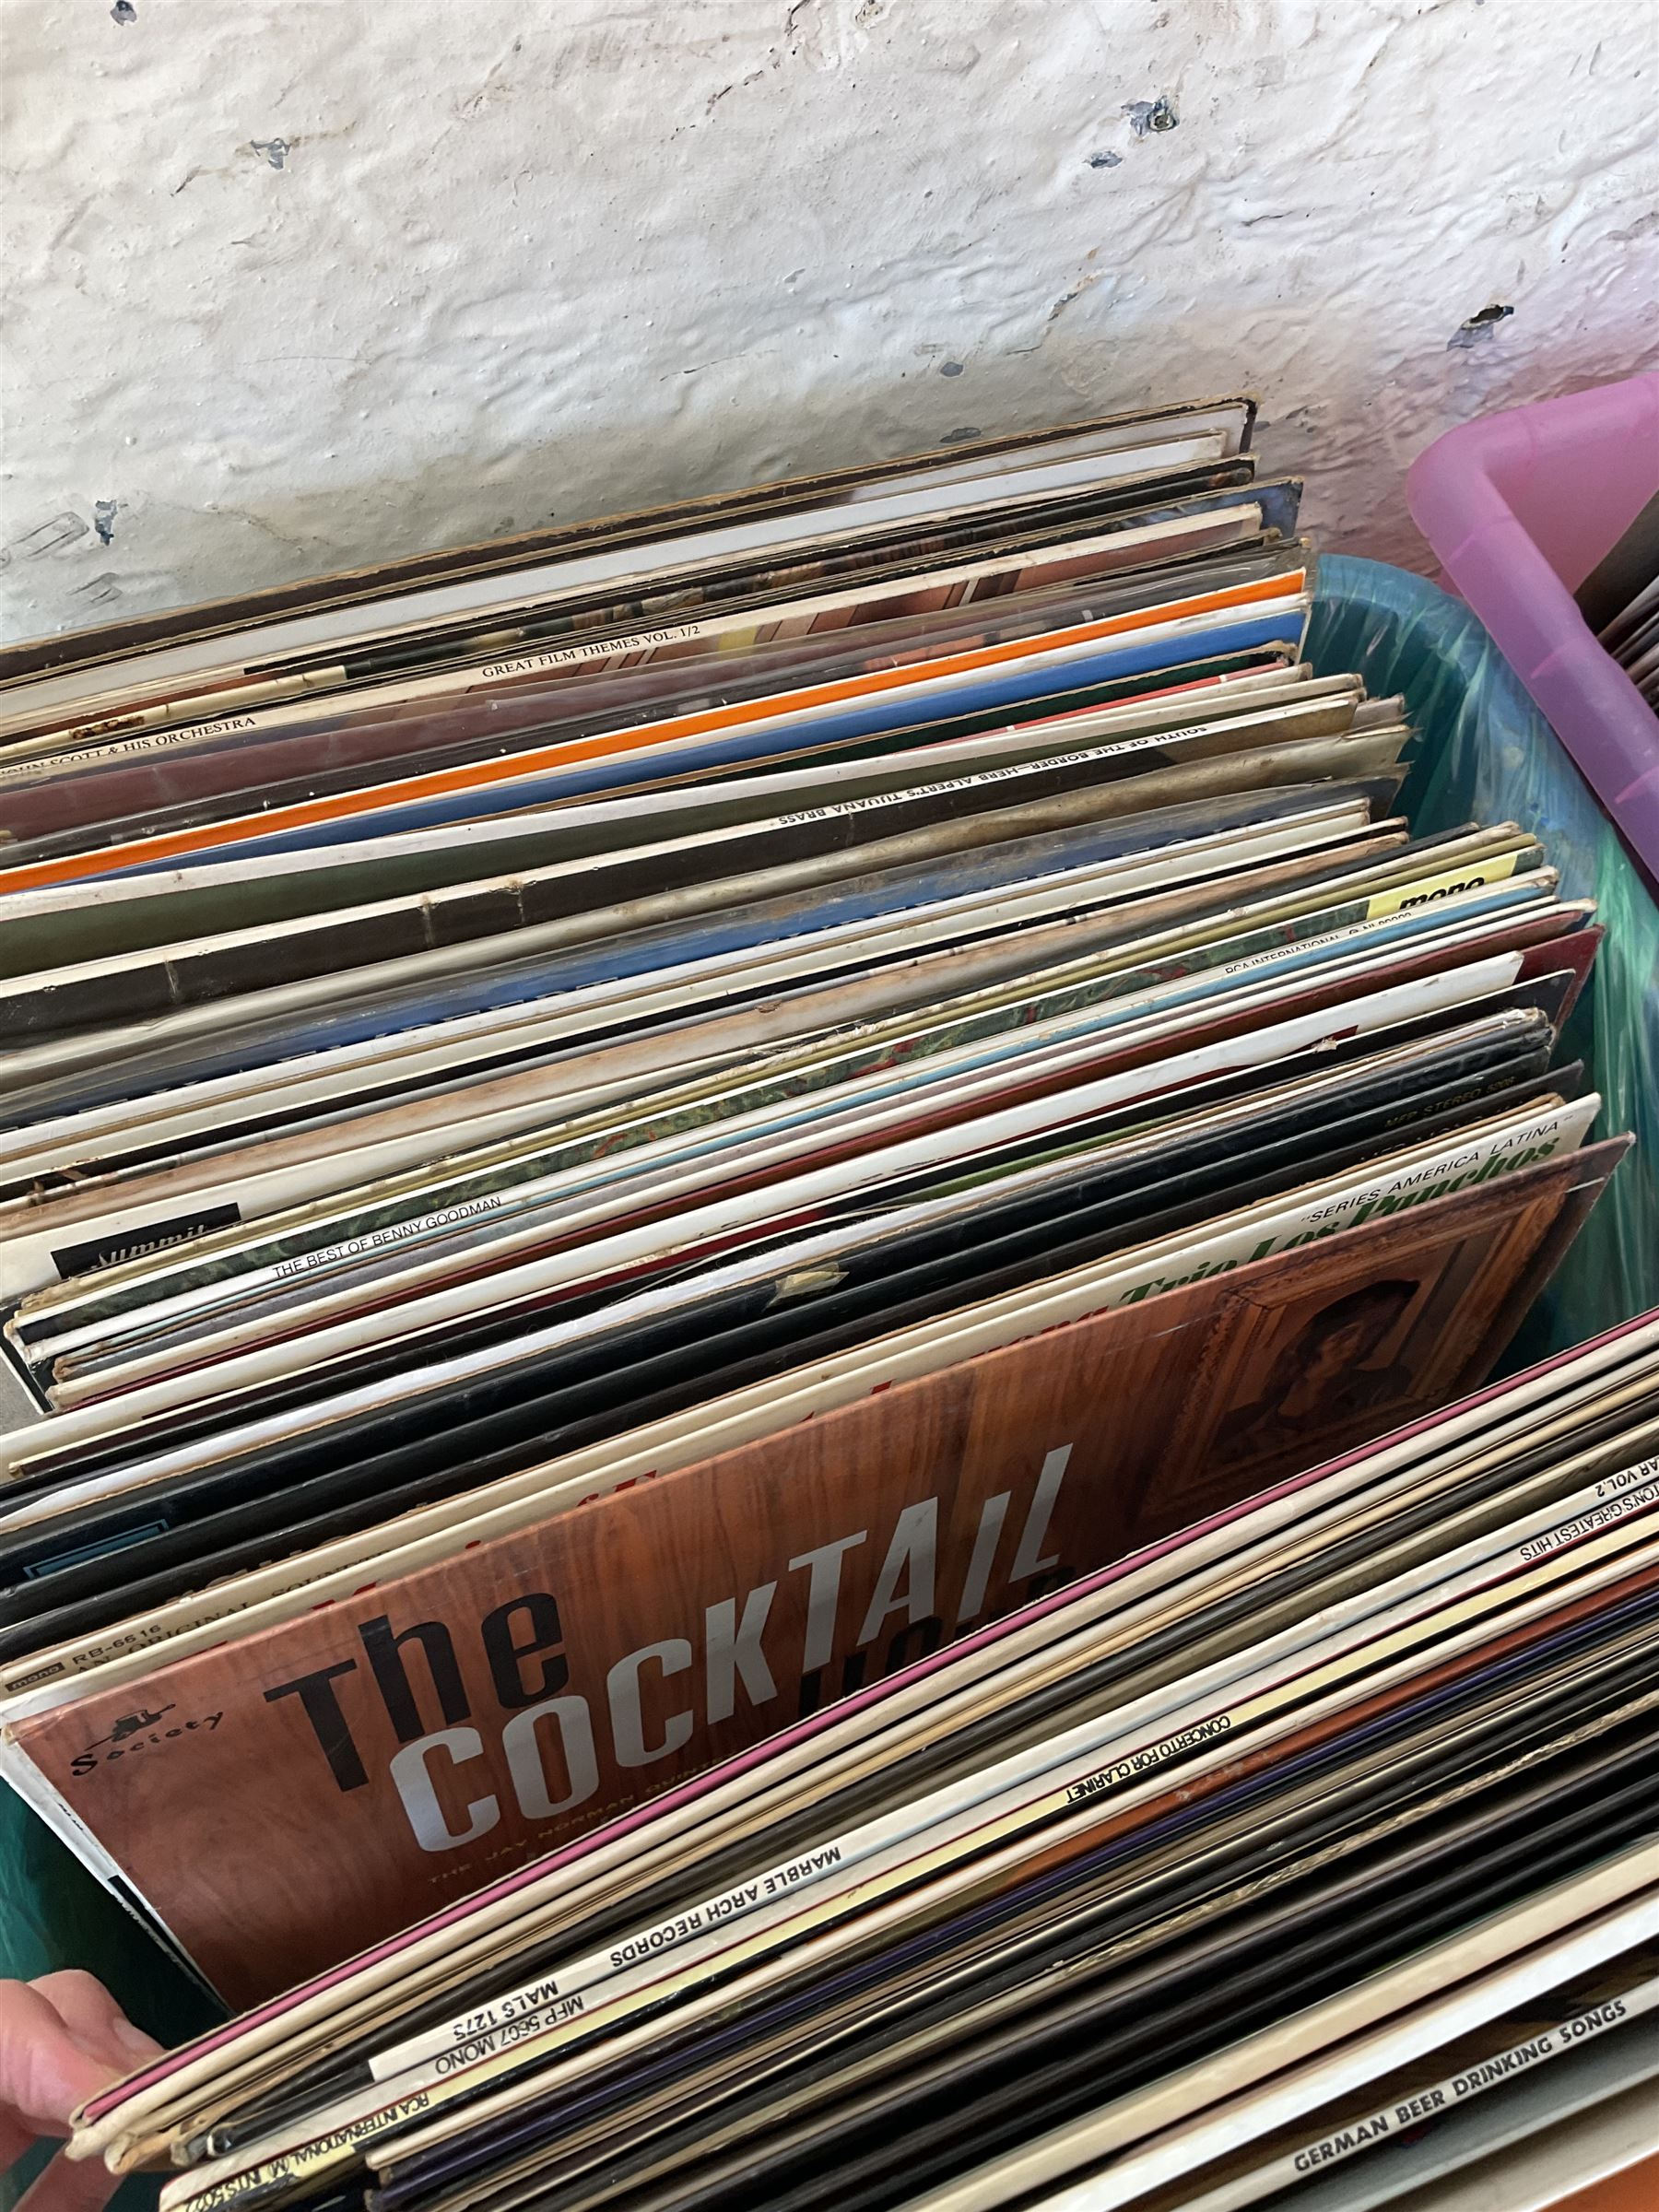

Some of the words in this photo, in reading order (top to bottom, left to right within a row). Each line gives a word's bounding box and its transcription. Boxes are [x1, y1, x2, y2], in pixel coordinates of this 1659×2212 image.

[482, 662, 535, 677] GREAT
[538, 651, 576, 666] FILM
[581, 638, 640, 657] THEMES
[642, 629, 677, 643] VOL.
[680, 625, 700, 638] 1/2
[108, 746, 119, 755] &
[124, 739, 151, 752] HIS
[155, 717, 257, 746] ORCHESTRA
[1093, 744, 1126, 757] THE
[1128, 739, 1148, 747] OF
[1154, 726, 1207, 743] SOUTH
[830, 792, 903, 814] TIJUANA
[906, 777, 972, 797] ALPERT'S
[778, 808, 828, 825] BRASS
[1387, 1152, 1479, 1194] AMERICA
[272, 1259, 303, 1278] THE
[307, 1245, 343, 1267] BEST
[348, 1238, 369, 1253] OF
[371, 1219, 421, 1246] BENNY
[426, 1196, 501, 1229] GOODMAN
[1554, 1503, 1623, 1547] GREATEST
[1520, 1537, 1554, 1561] HITS
[389, 1442, 1074, 1852] COCKTAIL
[264, 1592, 570, 1792] The
[70, 1712, 224, 1777] Society
[1159, 1715, 1231, 1758] CONCERTO
[1130, 1748, 1160, 1771] FOR
[1066, 1763, 1131, 1804] CLARINET
[429, 1864, 472, 1884] THE
[486, 1840, 528, 1862] JAY
[537, 1794, 635, 1839] NORMAN
[763, 1846, 841, 1895] MARBLE
[706, 1885, 758, 1923] ARCH
[610, 1912, 703, 1967] RECORDS
[501, 1981, 559, 2018] MALS
[545, 1995, 584, 2025] MFP
[453, 2010, 498, 2041] 1275
[435, 2035, 496, 2075] MONO
[402, 2092, 430, 2114] RCA
[1294, 2115, 1389, 2172] GERMAN
[1395, 2088, 1446, 2124] BEER
[1453, 2037, 1554, 2097] DRINKING
[1560, 2001, 1627, 2043] SONGS
[290, 2108, 399, 2165] INTERNATIONAL
